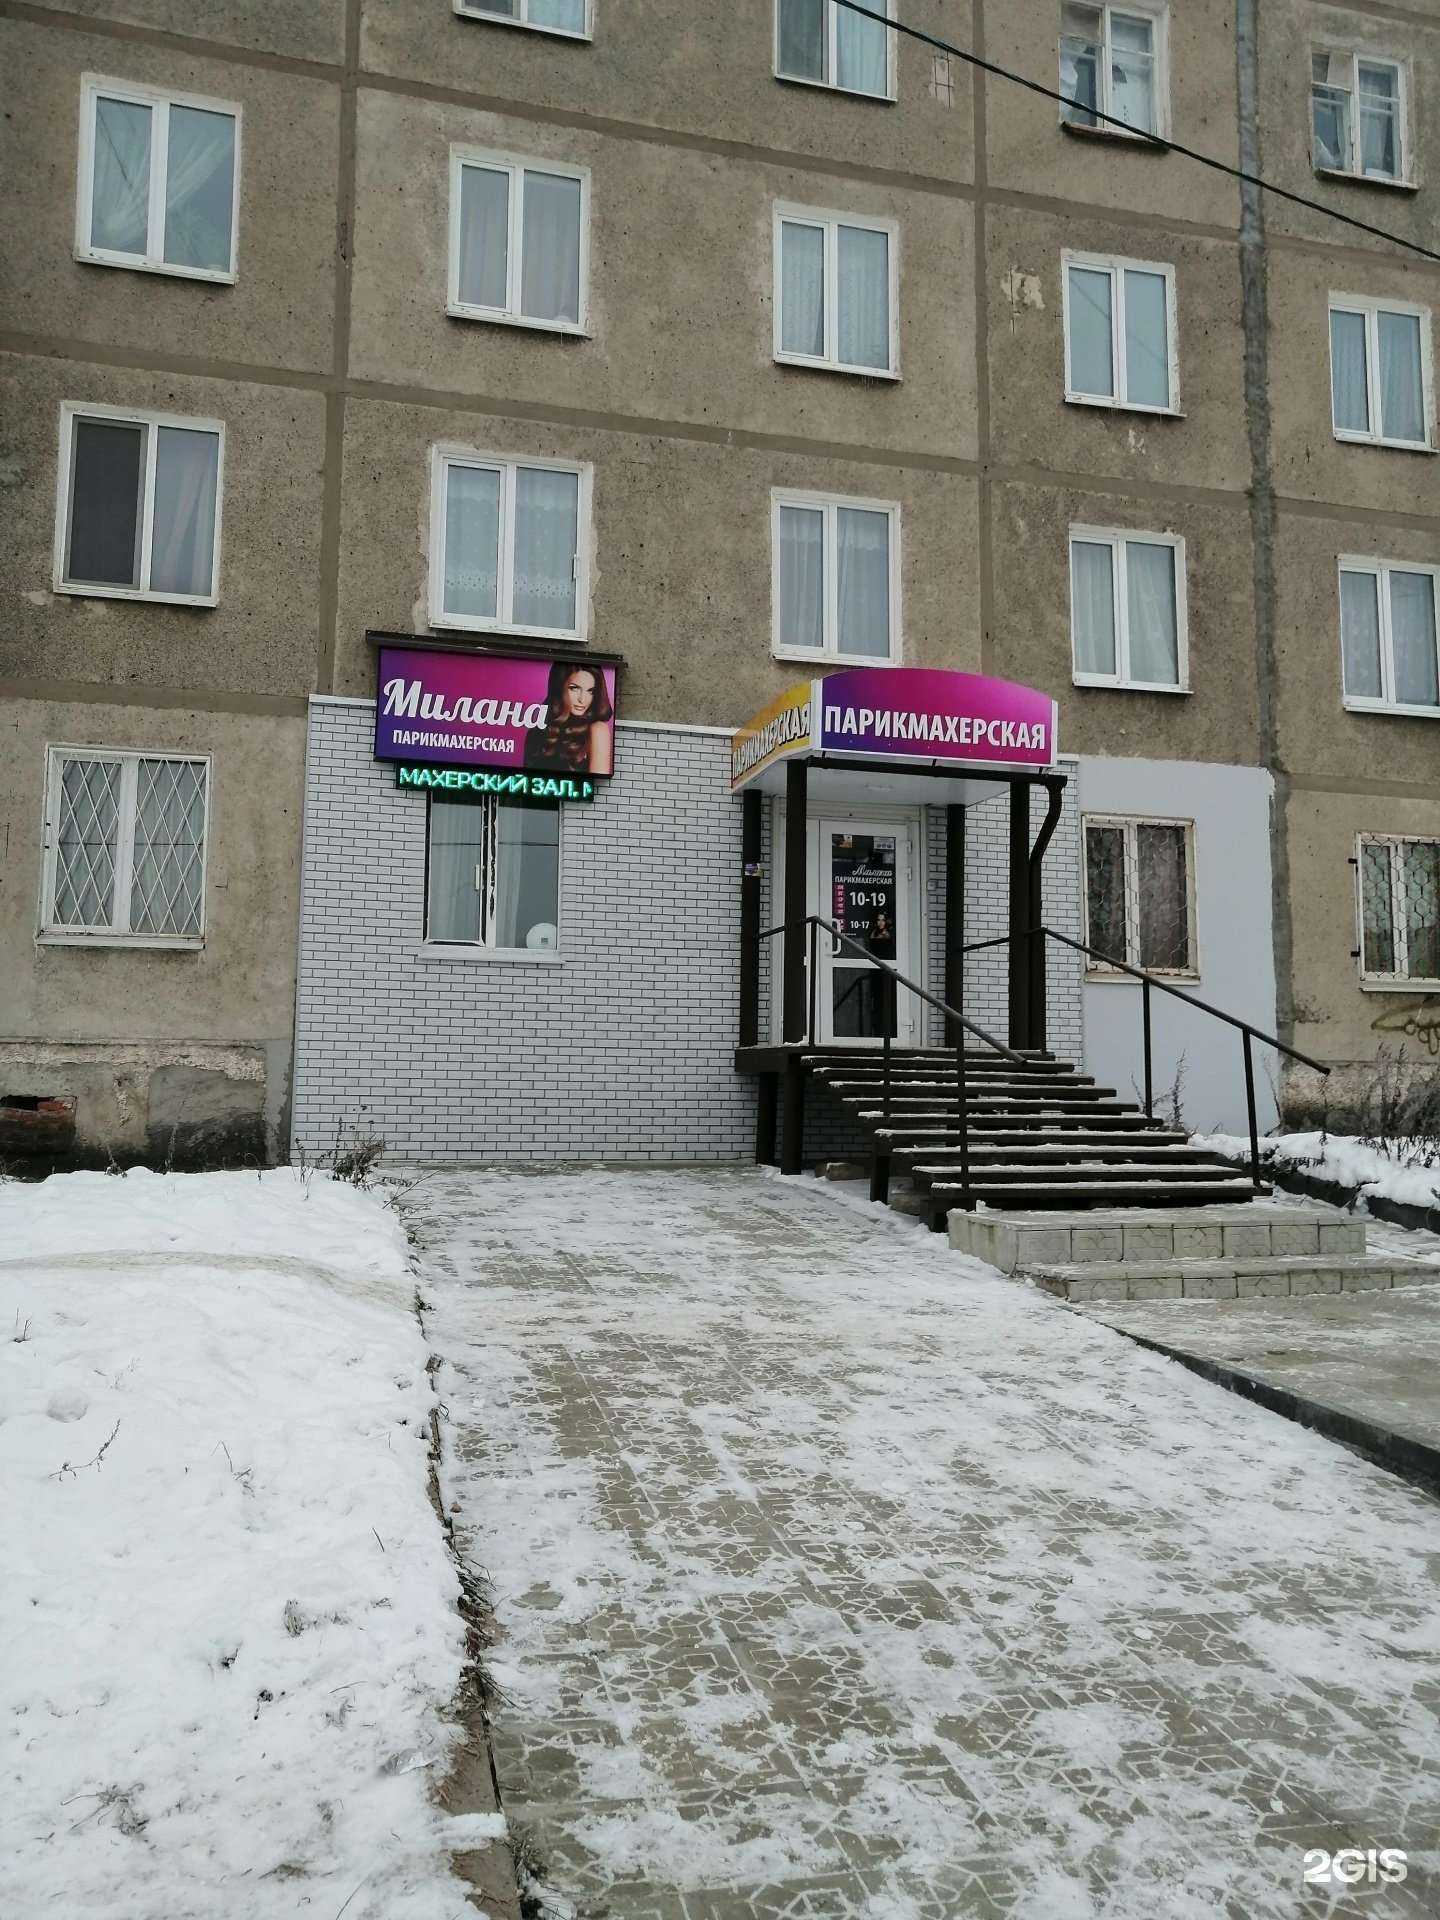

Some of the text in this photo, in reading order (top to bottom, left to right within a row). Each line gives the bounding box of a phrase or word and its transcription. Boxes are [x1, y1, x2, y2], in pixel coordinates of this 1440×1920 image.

[383, 678, 549, 730] Милана
[824, 705, 1046, 750] ПАРИКМАХЕРСКАЯ
[392, 729, 515, 753] ПАРИКМАХЕРСКАЯ
[399, 767, 527, 795] МАХЕРСКИЙ
[531, 777, 579, 798] ЗАЛ.
[834, 876, 893, 885] ПАРИКМАХЕРСКАЯ
[849, 891, 886, 907] 10-19
[850, 920, 870, 929] 10-17
